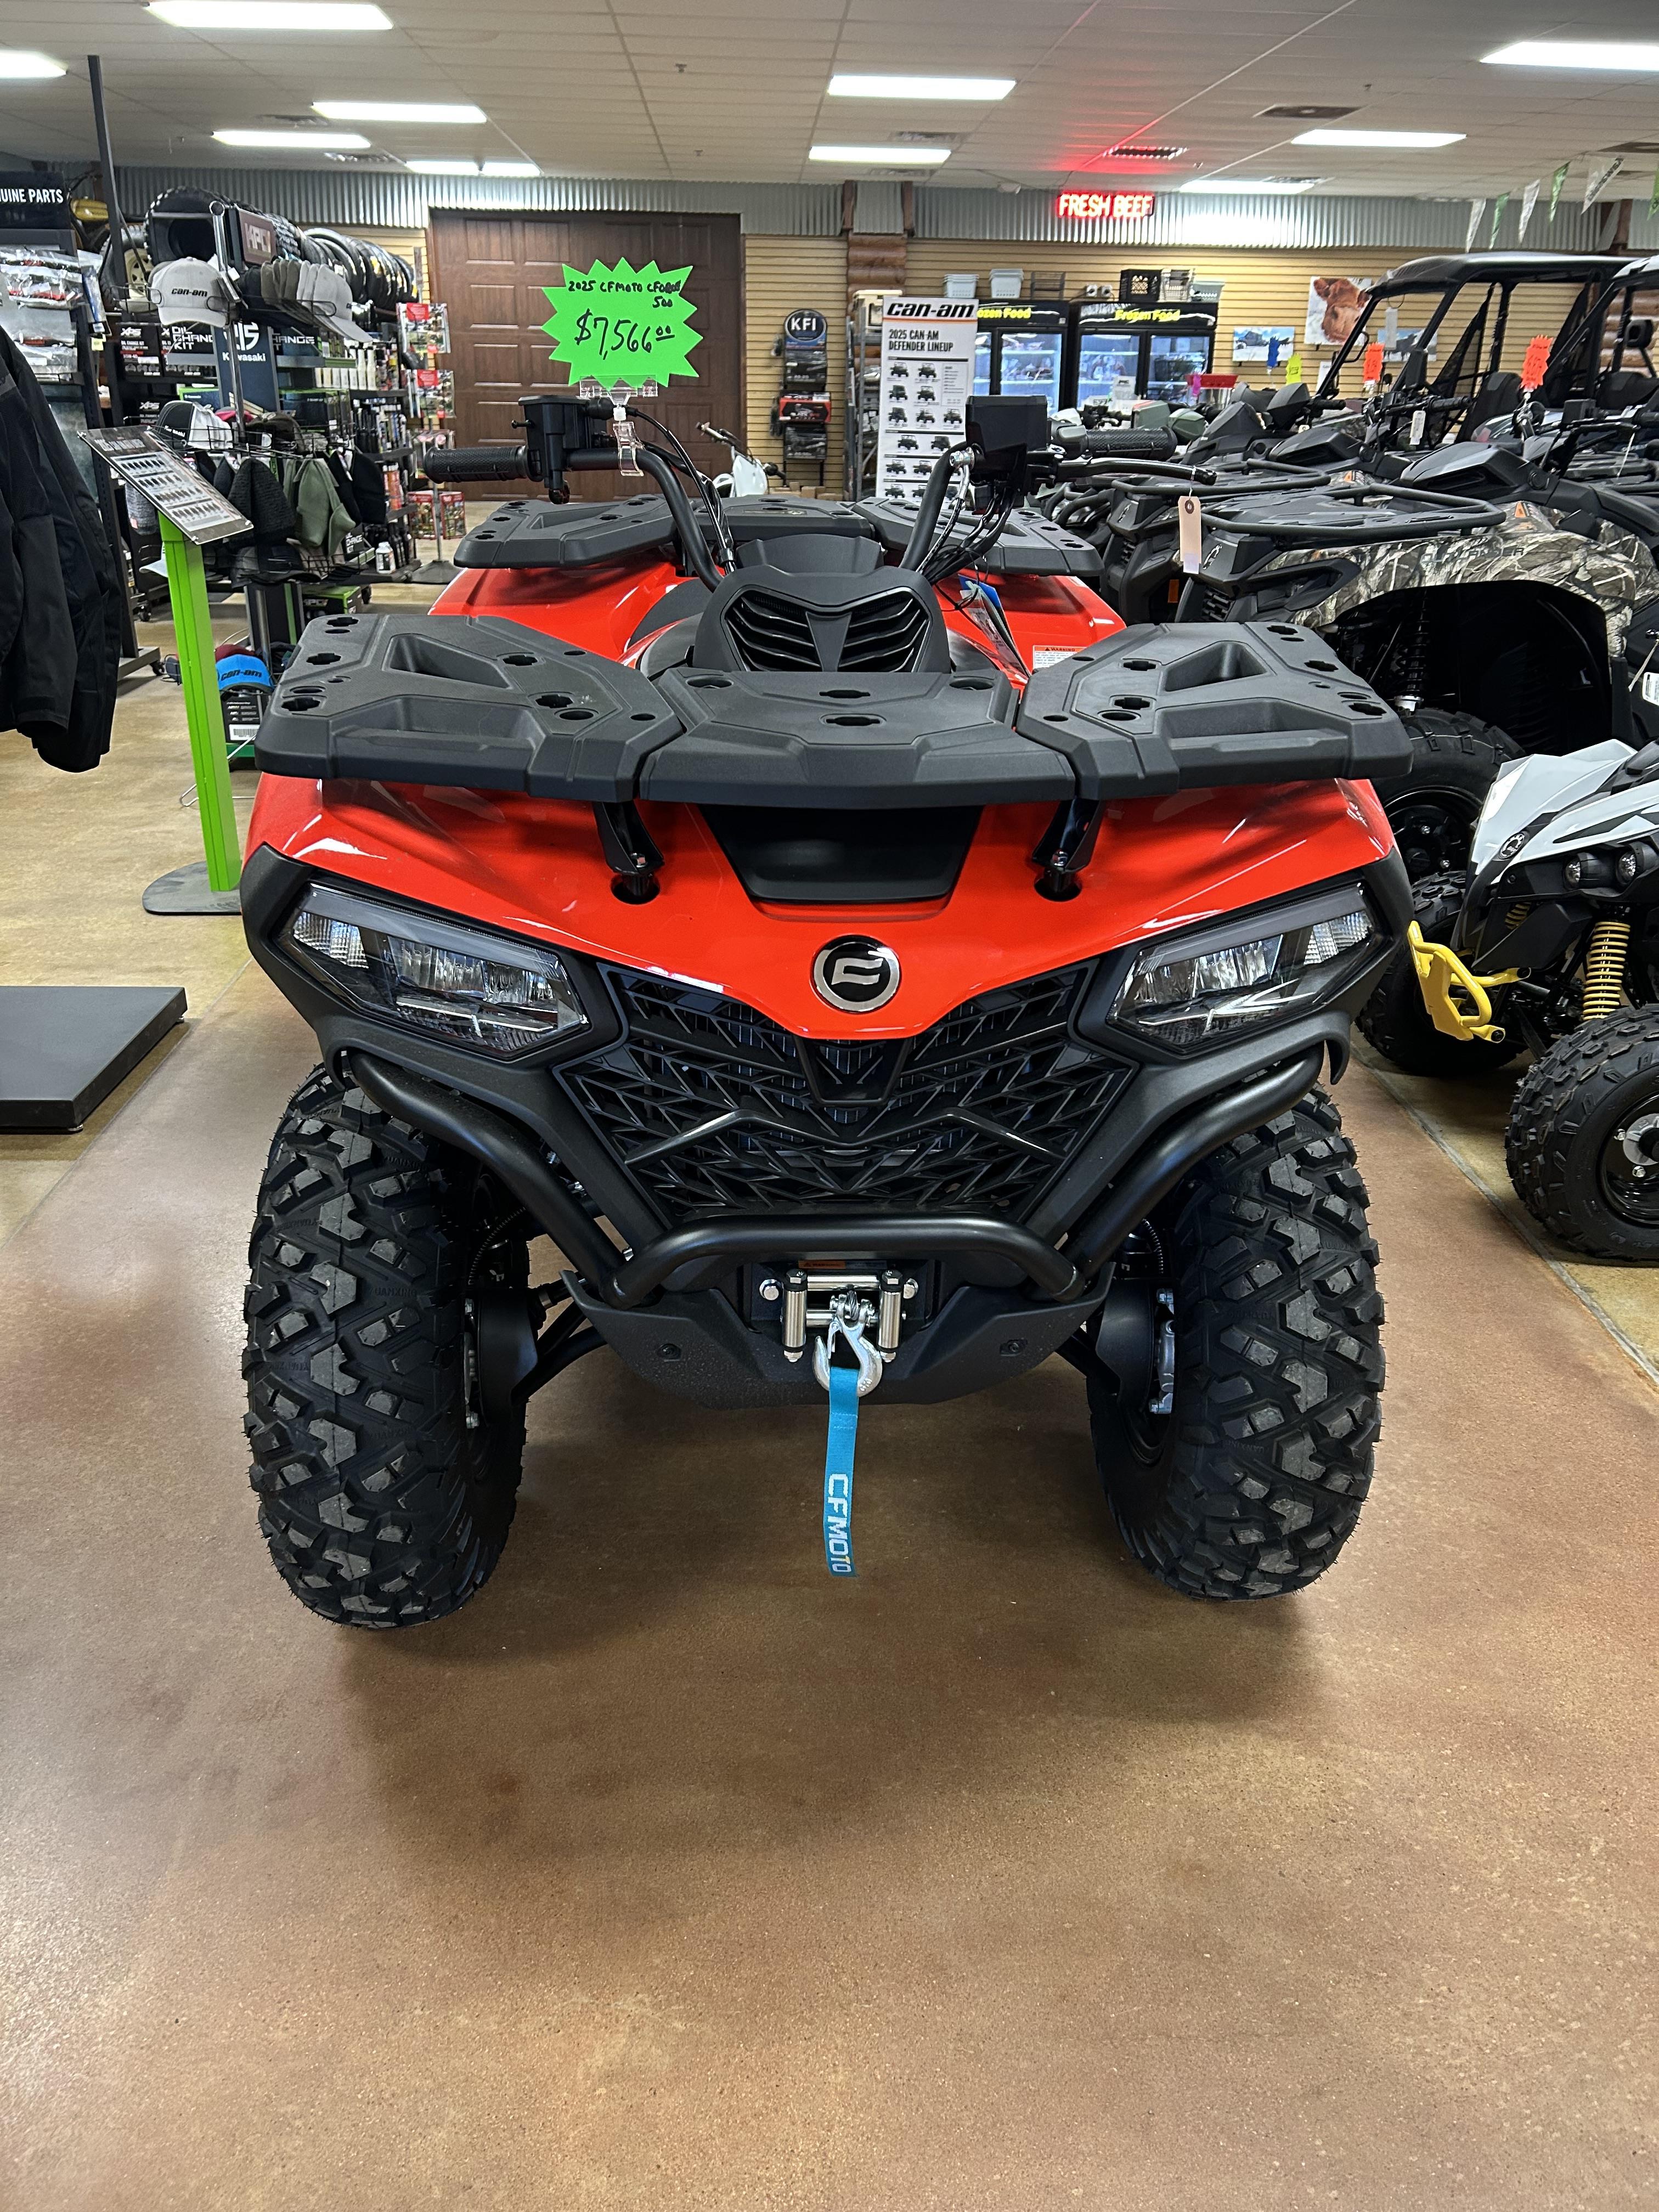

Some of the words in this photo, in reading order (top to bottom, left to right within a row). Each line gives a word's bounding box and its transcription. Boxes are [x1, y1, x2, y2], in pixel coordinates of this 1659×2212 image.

[0, 189, 26, 202] UINE
[29, 189, 64, 204] PARTS
[1059, 194, 1111, 217] FRESH
[1114, 194, 1153, 218] BEEF
[171, 287, 208, 297] can-am
[568, 280, 596, 292] 2025
[600, 281, 643, 293] CFMOTO
[652, 296, 673, 308] 500
[887, 303, 974, 318] can-am
[977, 308, 1002, 319] ozen
[1003, 307, 1032, 319] Food
[1115, 309, 1152, 321] Frozen
[1152, 309, 1181, 322] Food
[791, 317, 816, 331] KFI
[172, 334, 213, 343] CHAN
[272, 335, 315, 344] HANGE
[889, 329, 907, 339] 2025
[910, 330, 940, 340] CAN-AM
[889, 341, 926, 351] DEFENDER
[928, 342, 953, 352] LINEUP
[222, 352, 266, 362] Kwasaki
[221, 669, 262, 681] can-am
[827, 1474, 852, 1573] CFMOTO
